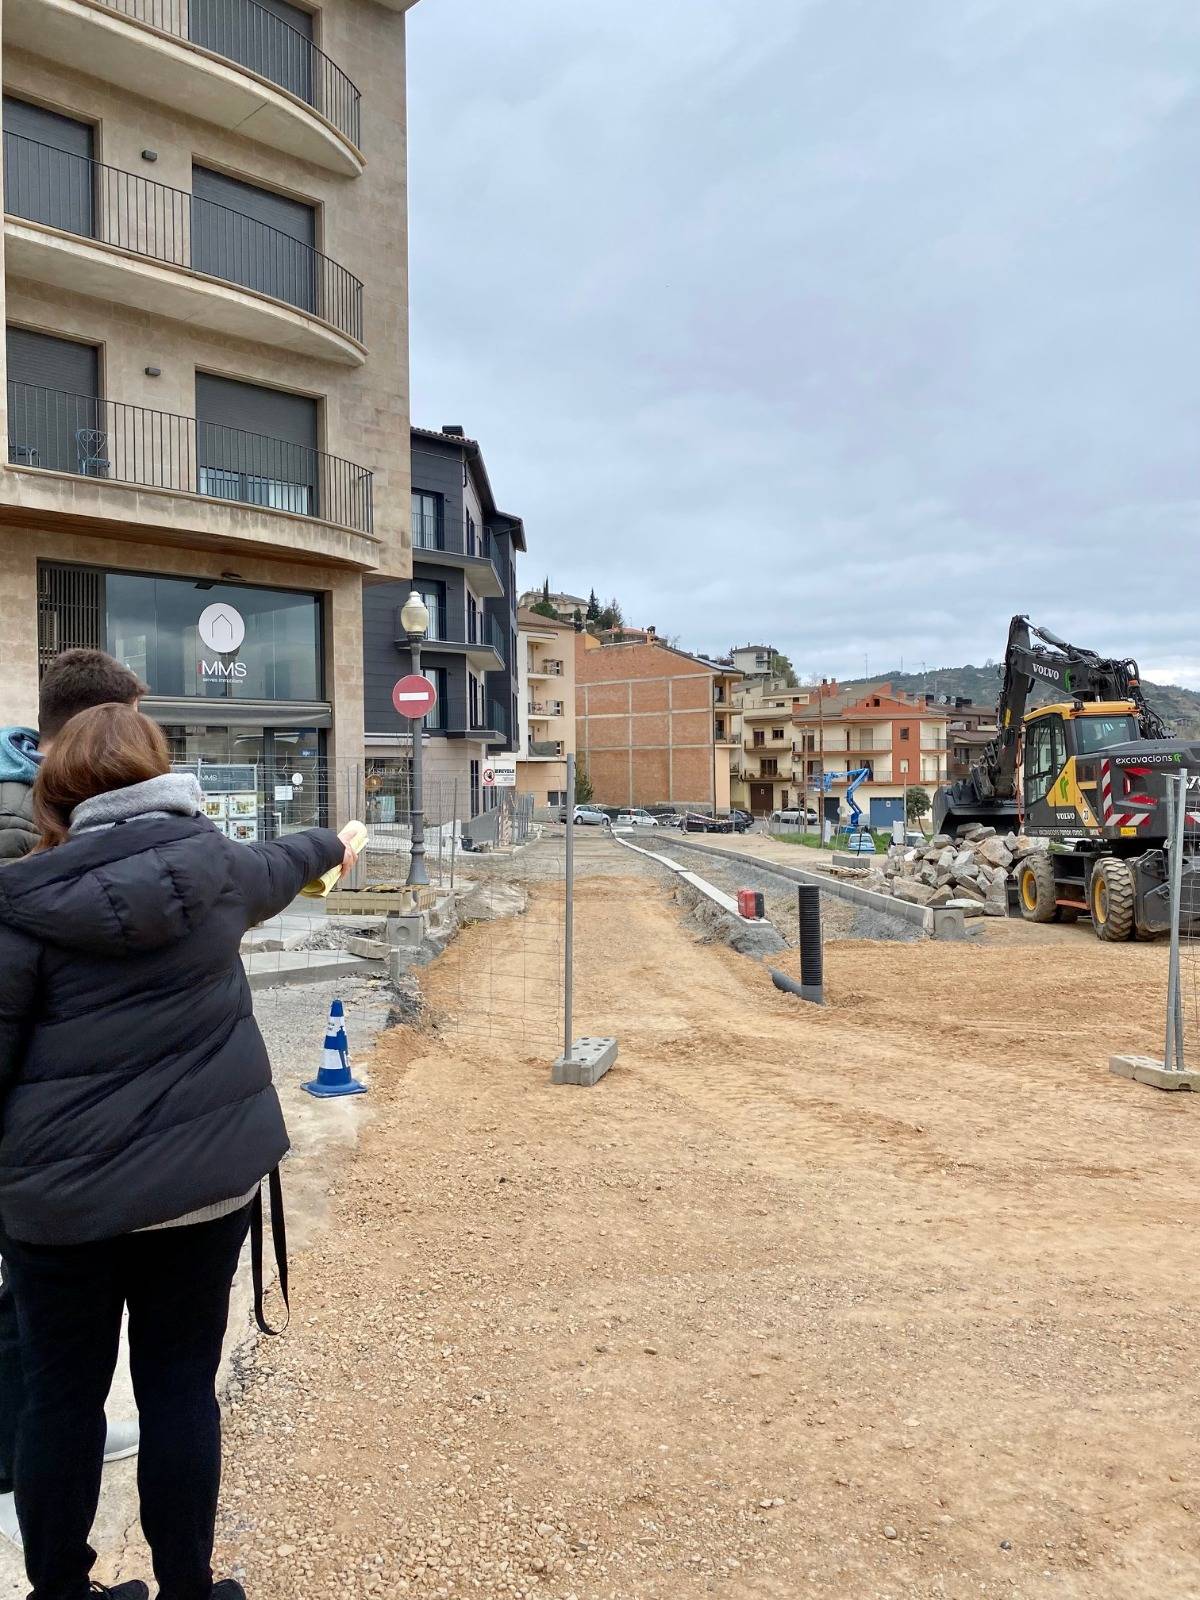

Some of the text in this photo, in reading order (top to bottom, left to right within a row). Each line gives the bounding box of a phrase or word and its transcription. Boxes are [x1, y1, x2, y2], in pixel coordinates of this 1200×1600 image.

[1032, 663, 1060, 680] VOLVO
[1115, 754, 1172, 764] excavacions
[1056, 812, 1076, 820] VOLVO
